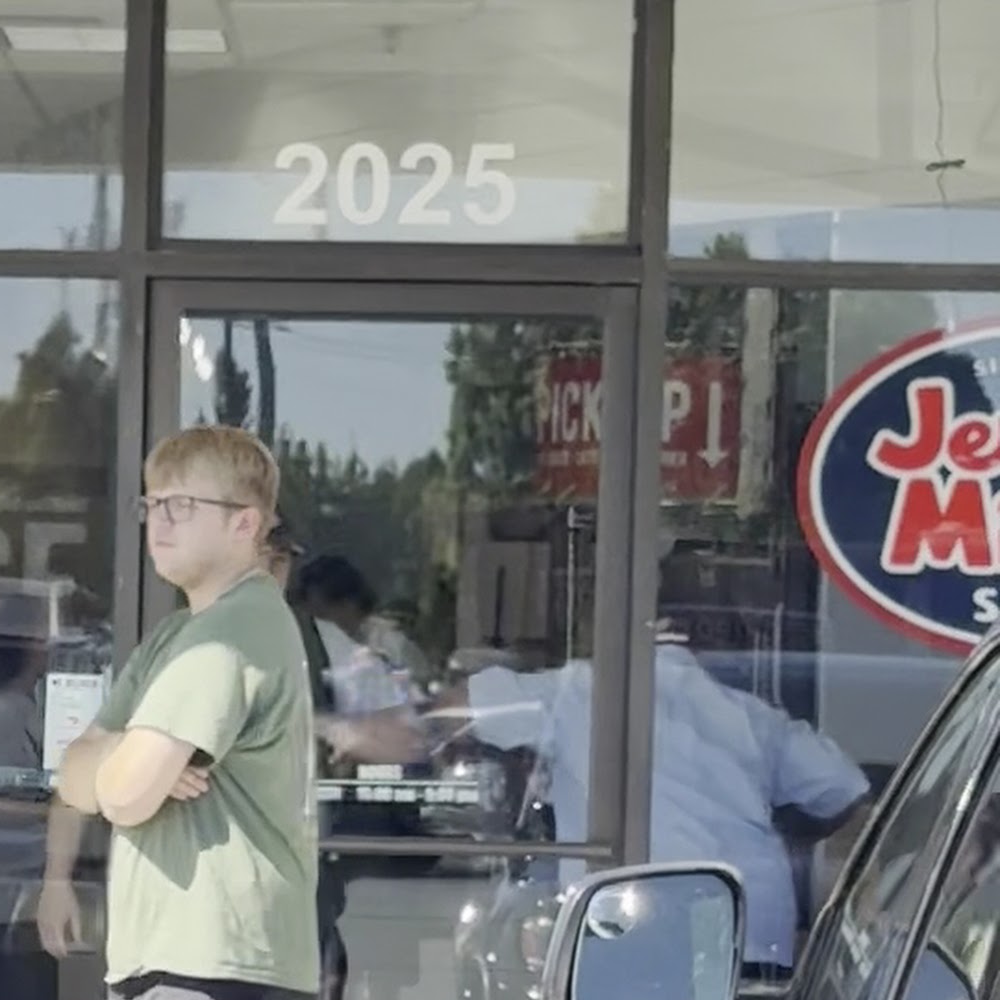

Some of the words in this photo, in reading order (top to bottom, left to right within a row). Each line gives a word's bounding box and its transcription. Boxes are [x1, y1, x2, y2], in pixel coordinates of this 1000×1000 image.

[273, 142, 516, 225] 2025
[866, 376, 1000, 480] Je
[881, 474, 1000, 576] M
